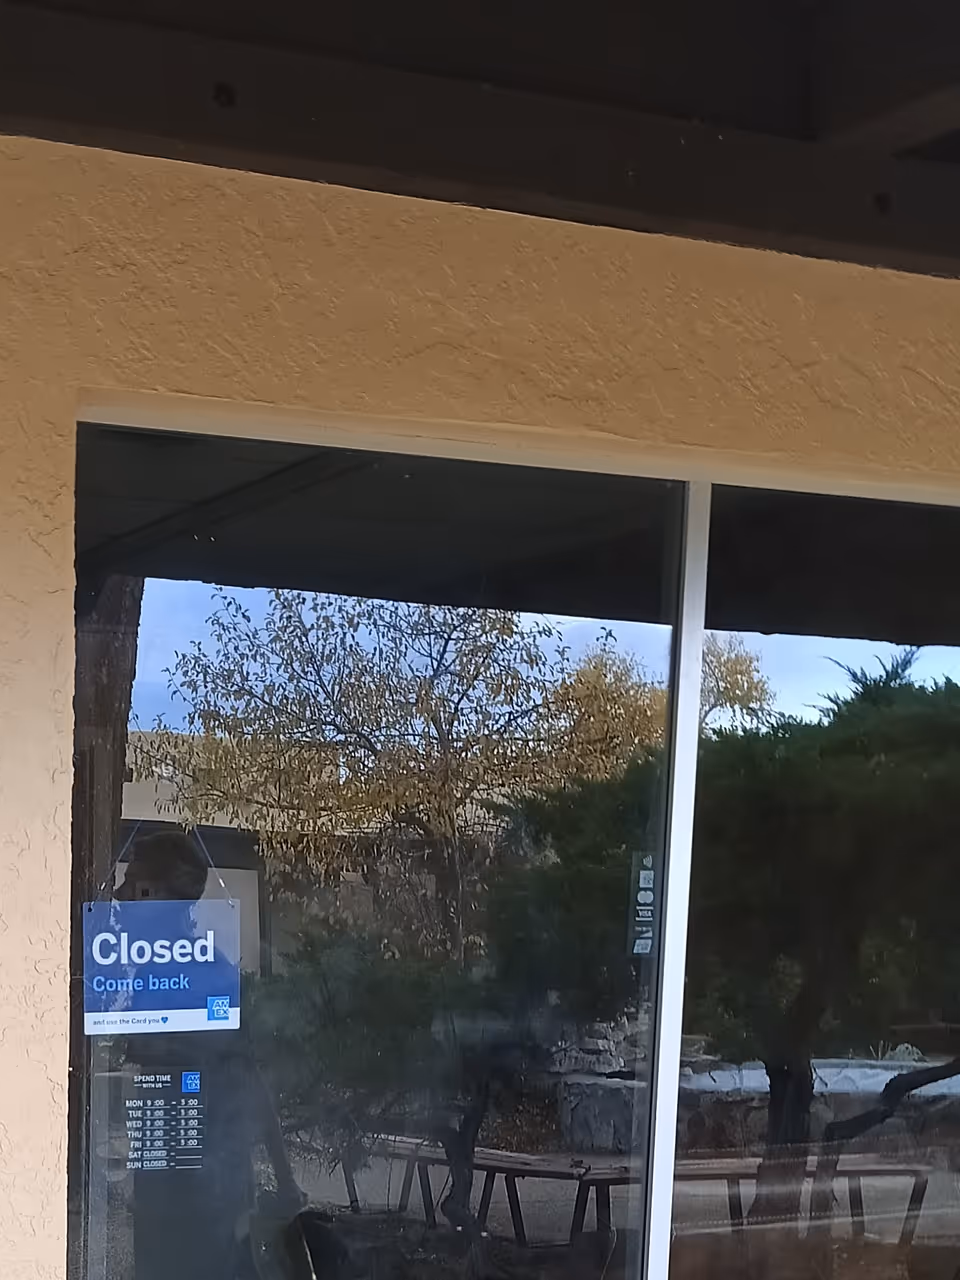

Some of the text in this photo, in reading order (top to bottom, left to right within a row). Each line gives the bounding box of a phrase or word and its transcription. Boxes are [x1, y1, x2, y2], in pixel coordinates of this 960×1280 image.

[92, 930, 215, 966] Closed
[93, 973, 190, 993] Come back
[93, 1018, 105, 1026] and
[131, 1017, 147, 1025] Card
[148, 1018, 160, 1026] you
[125, 1100, 143, 1108] MON
[128, 1110, 143, 1118] TUE
[125, 1120, 143, 1128] WED
[128, 1151, 142, 1159] SAT
[126, 1161, 142, 1169] SUN
